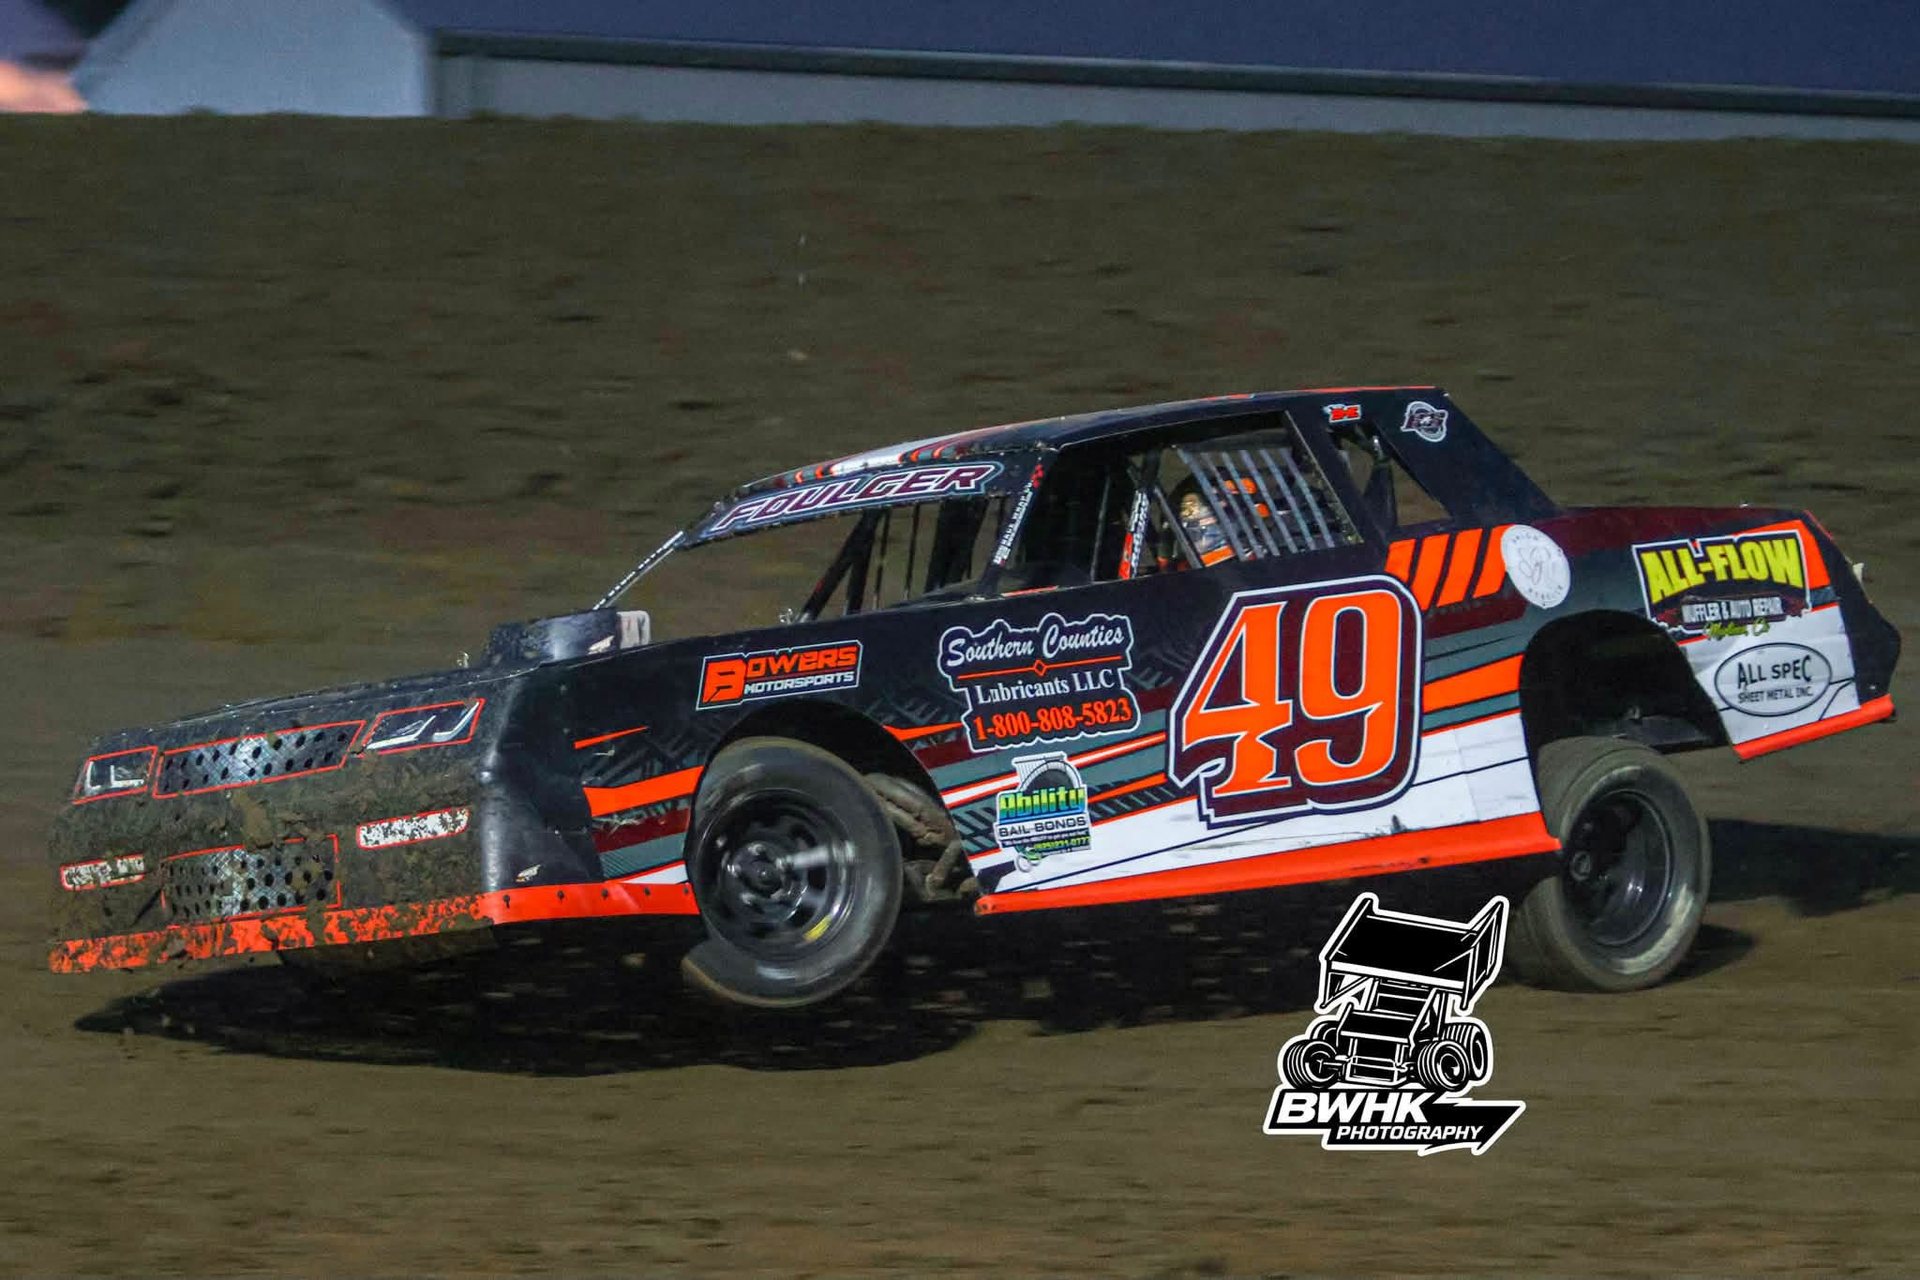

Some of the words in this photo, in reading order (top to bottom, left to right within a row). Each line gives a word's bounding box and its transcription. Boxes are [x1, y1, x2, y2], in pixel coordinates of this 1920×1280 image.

[709, 463, 996, 531] FOULGER
[1641, 537, 1804, 605] ALL-FLOW
[946, 630, 1035, 667] Southern
[1042, 623, 1125, 659] Counties
[743, 671, 855, 695] MOTORSPORTS
[975, 678, 1070, 705] Lubricants
[1071, 668, 1115, 692] LLC
[1182, 588, 1402, 798] 49
[1737, 661, 1767, 689] ALL
[1771, 654, 1812, 682] SPEC
[973, 696, 1133, 742] 1-800-808-5823
[998, 825, 1030, 838] BAIL
[1034, 816, 1087, 833] BONDS
